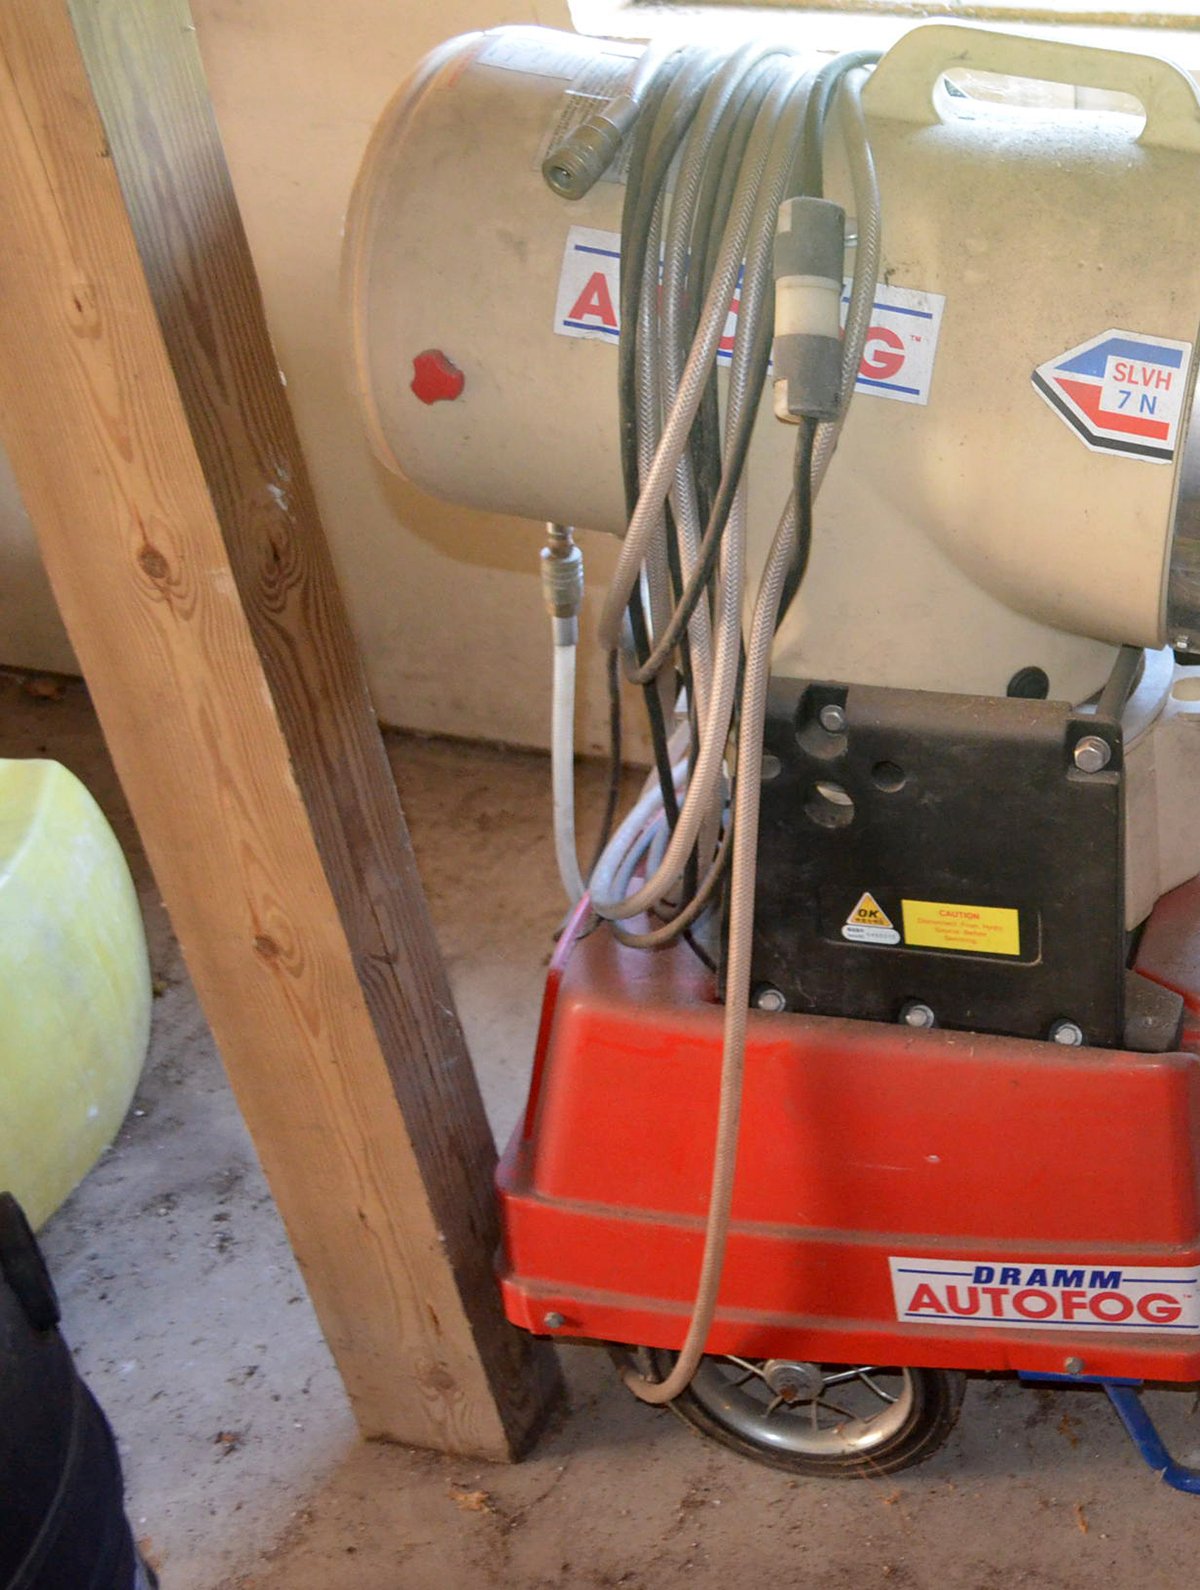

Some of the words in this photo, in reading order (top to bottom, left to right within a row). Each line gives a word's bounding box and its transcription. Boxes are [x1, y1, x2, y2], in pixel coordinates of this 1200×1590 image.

[1112, 362, 1172, 390] SLVH
[1117, 390, 1132, 409] 7
[1139, 394, 1157, 415] N
[857, 908, 879, 919] OK
[938, 909, 980, 921] CAUTION
[971, 1265, 1122, 1289] DRAMM
[907, 1283, 1183, 1324] AUTOFOG
